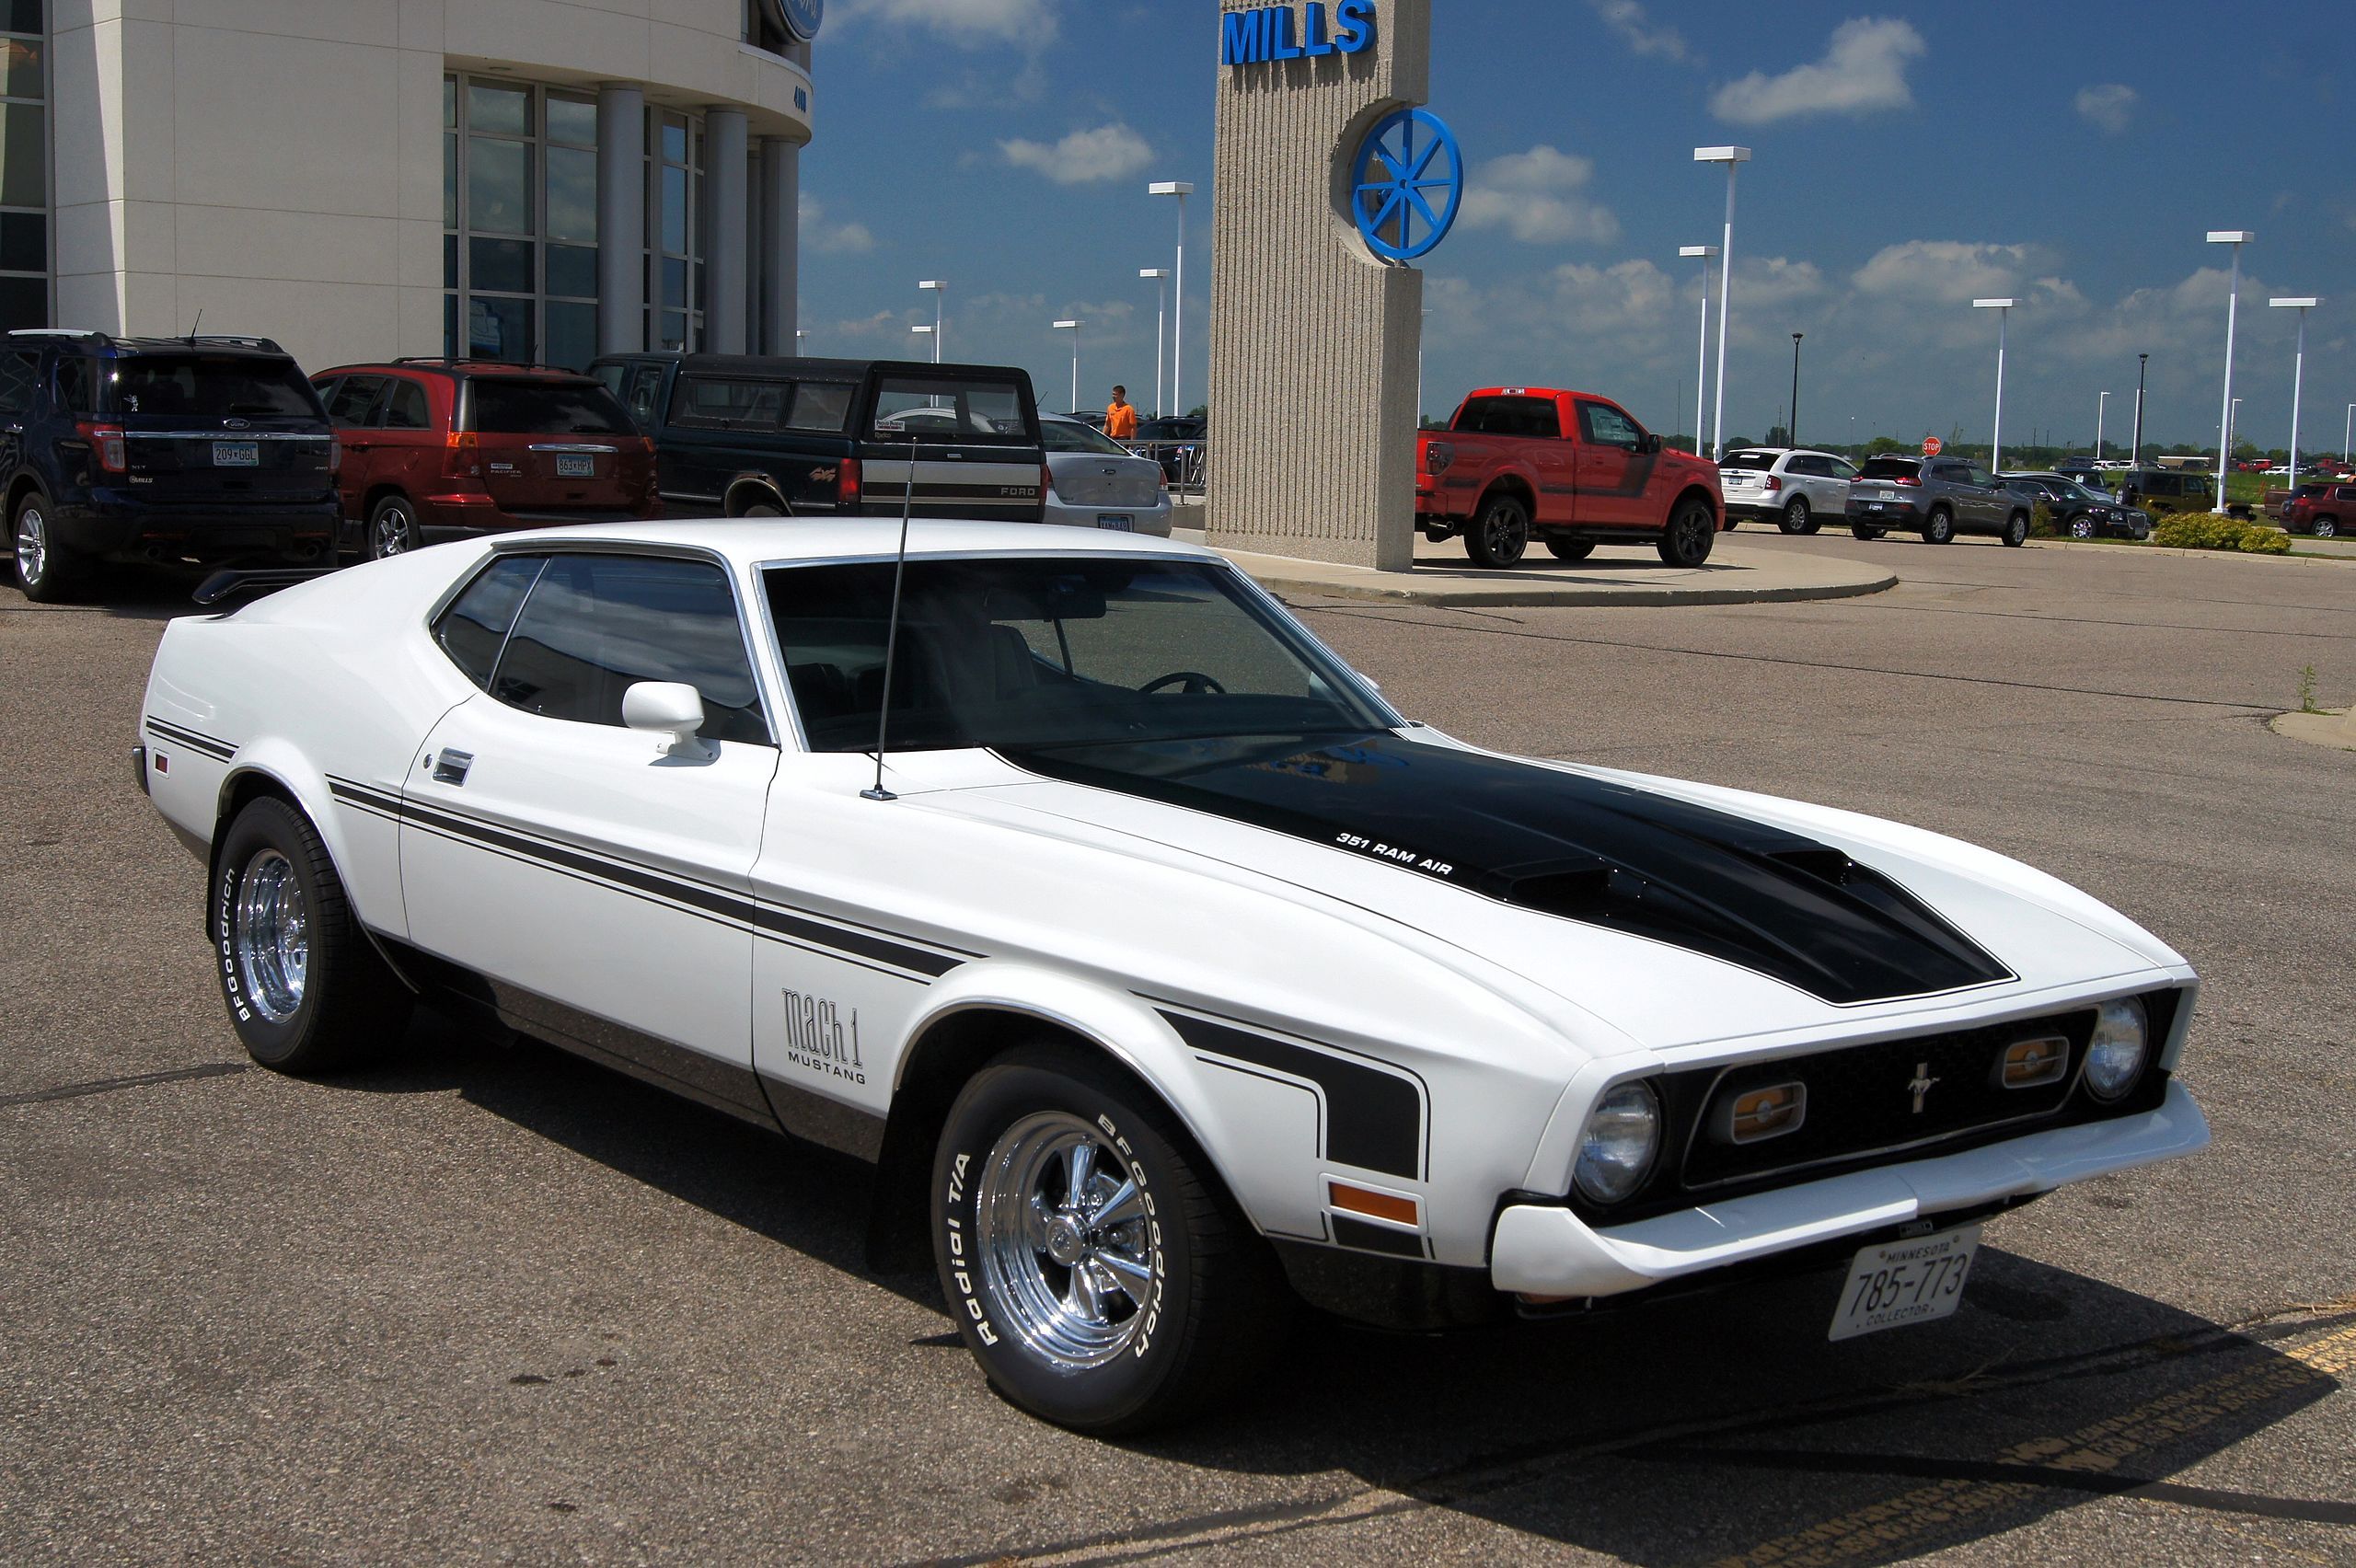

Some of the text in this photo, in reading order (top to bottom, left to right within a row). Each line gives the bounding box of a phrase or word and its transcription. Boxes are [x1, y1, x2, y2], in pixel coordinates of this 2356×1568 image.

[1222, 0, 1377, 65] MILLS
[216, 448, 233, 460] 209
[559, 460, 572, 471] 863
[1923, 443, 1939, 451] STOP
[1000, 487, 1035, 496] FORD
[1335, 832, 1453, 875] 351 RAM AIR
[220, 868, 250, 1021] BFGoodrich
[850, 1008, 863, 1069] 1
[788, 1051, 866, 1085] MUSTANG
[948, 1154, 999, 1346] Radial T/A
[1098, 1113, 1165, 1358] BFGoodrich
[1887, 1241, 1950, 1262] MINNESOTA
[1850, 1252, 1968, 1317] 785-773
[1866, 1303, 1929, 1326] COLLECTOR
